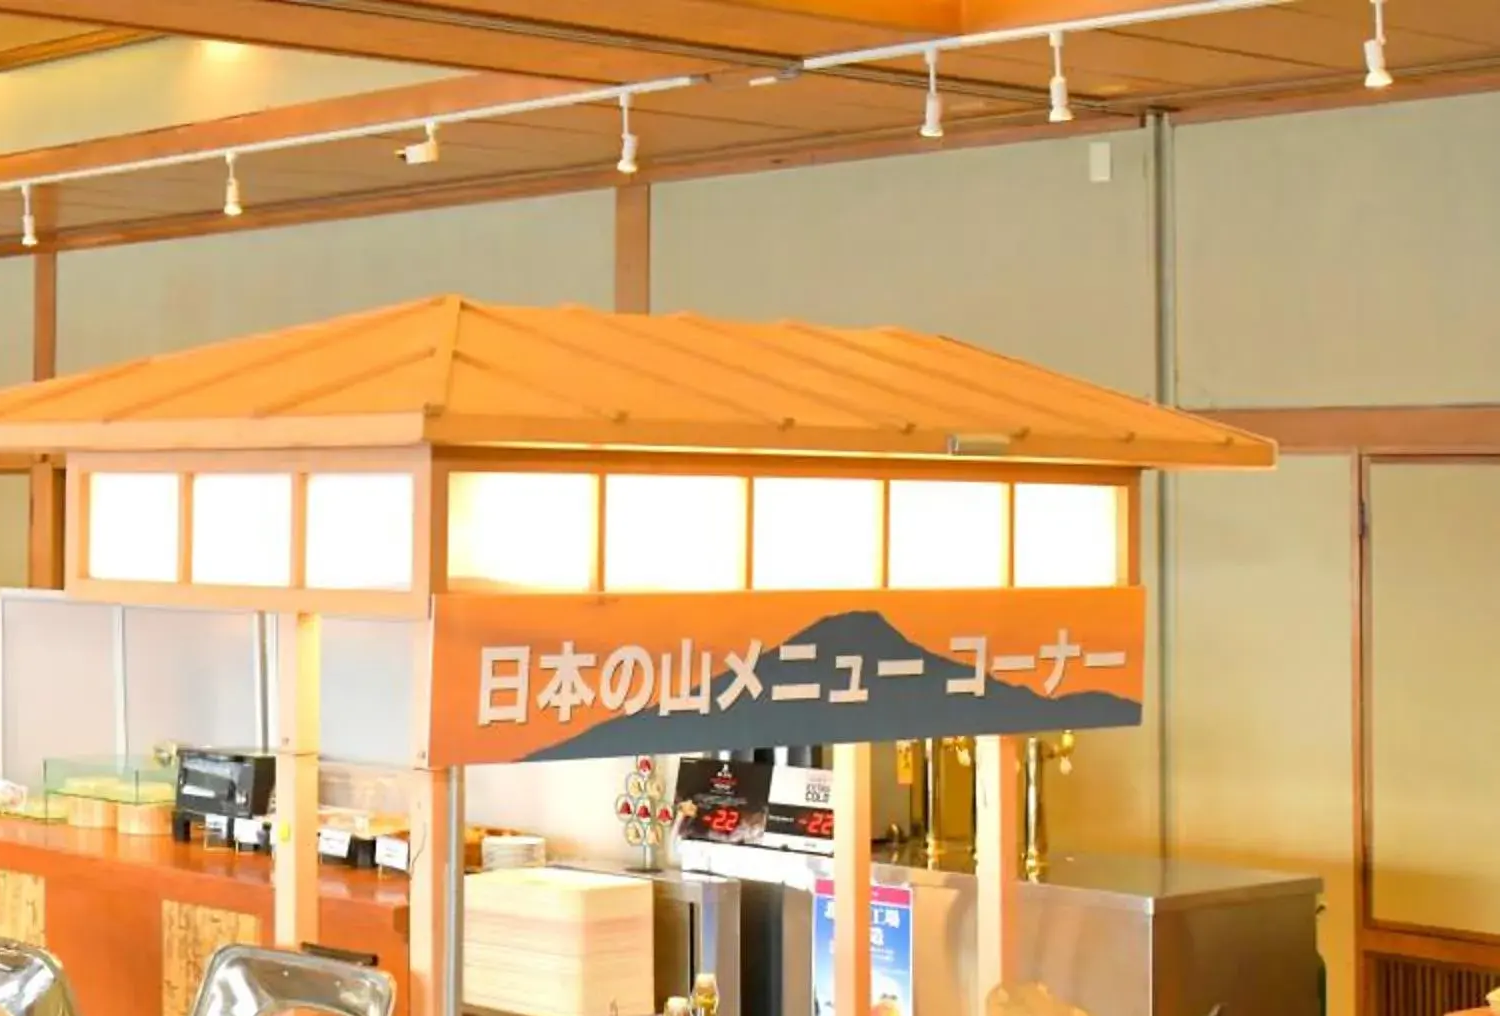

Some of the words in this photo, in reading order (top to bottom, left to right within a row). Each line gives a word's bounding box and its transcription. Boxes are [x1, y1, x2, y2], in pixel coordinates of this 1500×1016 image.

[478, 638, 925, 726] 日本の山メニュー
[945, 628, 1127, 697] コーナー
